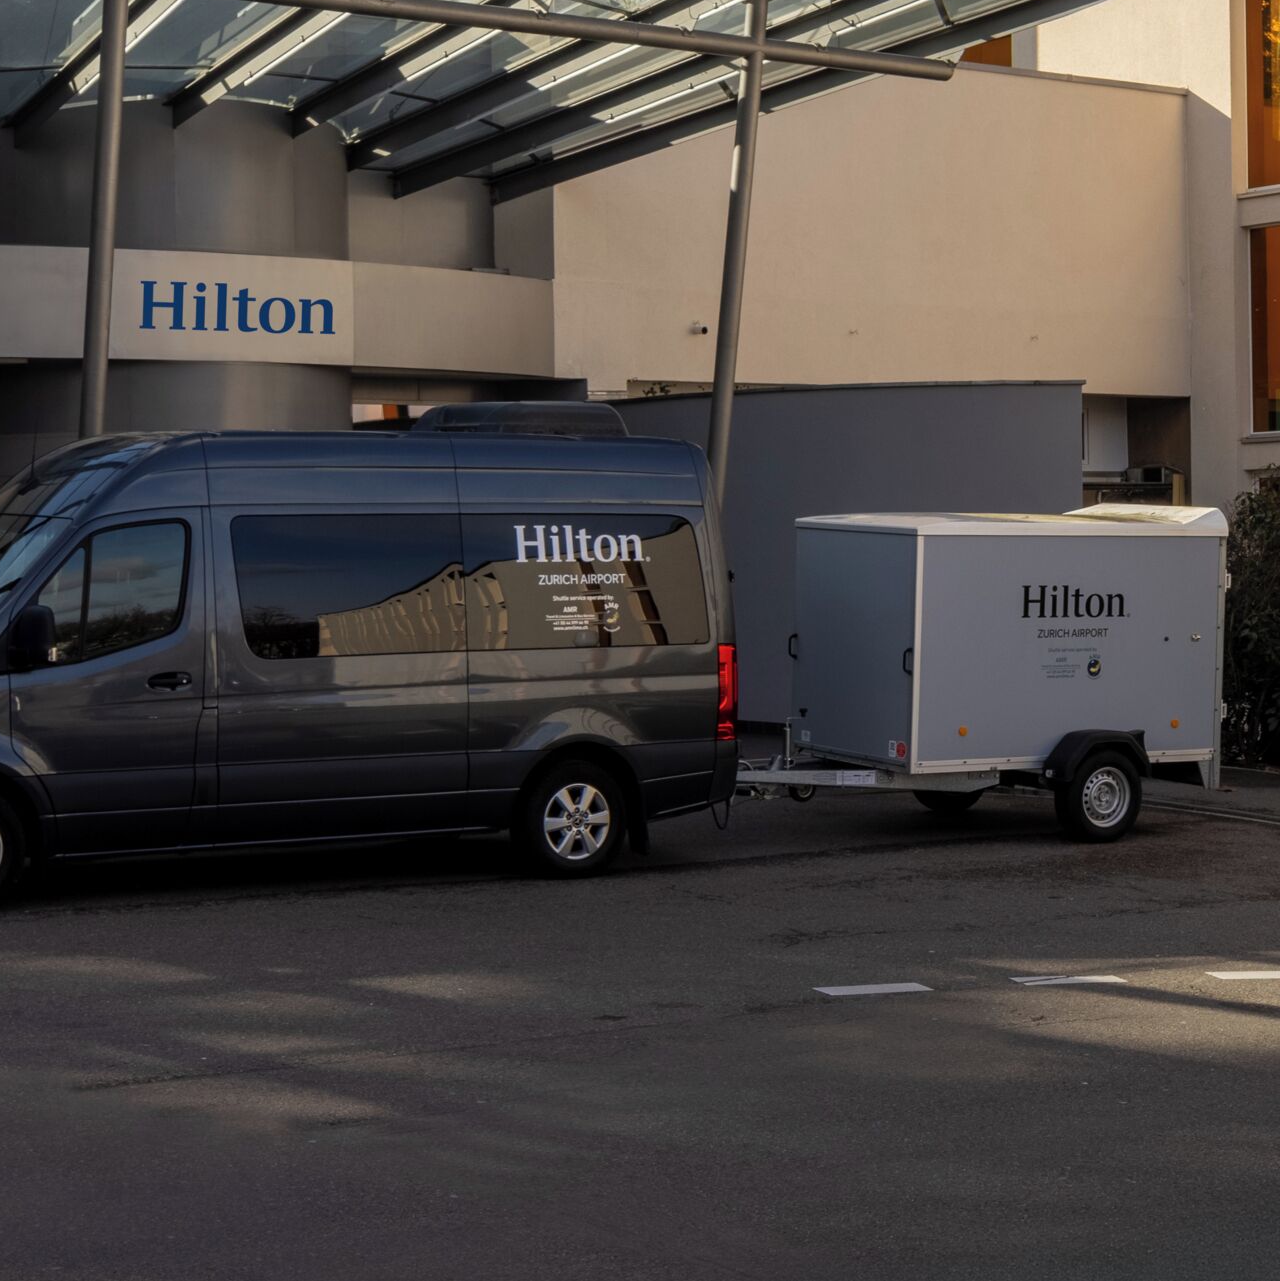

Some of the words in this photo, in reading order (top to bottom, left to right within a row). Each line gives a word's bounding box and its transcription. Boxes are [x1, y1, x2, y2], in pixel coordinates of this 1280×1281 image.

[139, 280, 336, 335] Hilton
[514, 524, 645, 563] Hilton
[538, 574, 579, 586] ZURICH
[580, 573, 626, 585] AIRPORT
[604, 602, 619, 610] AMR
[1021, 584, 1125, 618] Hilton
[1037, 629, 1070, 639] ZURICH
[1072, 628, 1109, 638] AIRPORT
